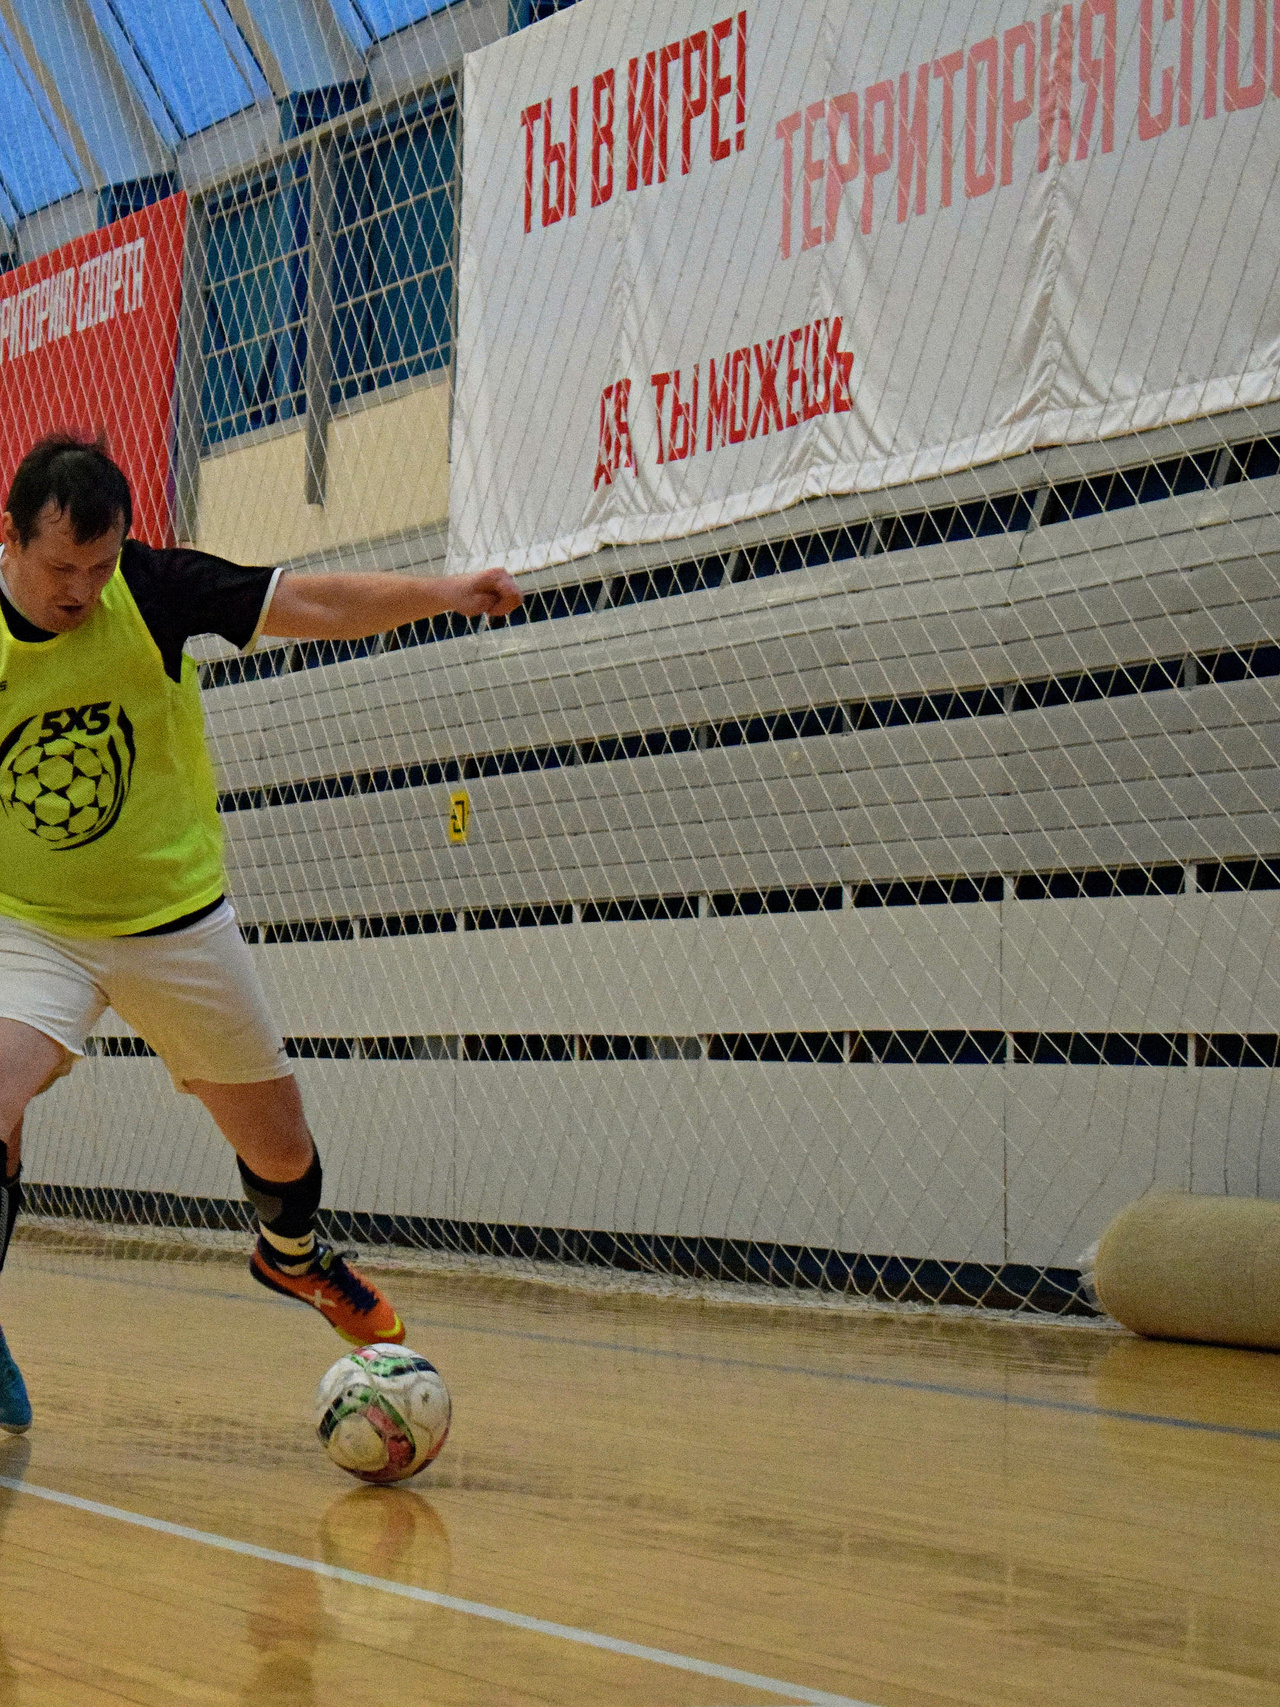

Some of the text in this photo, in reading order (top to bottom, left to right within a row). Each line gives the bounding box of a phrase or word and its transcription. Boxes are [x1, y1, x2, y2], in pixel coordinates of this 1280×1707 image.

[520, 10, 747, 234] ТЫ В ИГРЕ!
[775, 0, 1280, 261] ТЕРРИТОРИЯ СПО
[76, 237, 145, 332] СПОРТА
[593, 316, 854, 492] ДА, ТЫ МОЖЕШЬ
